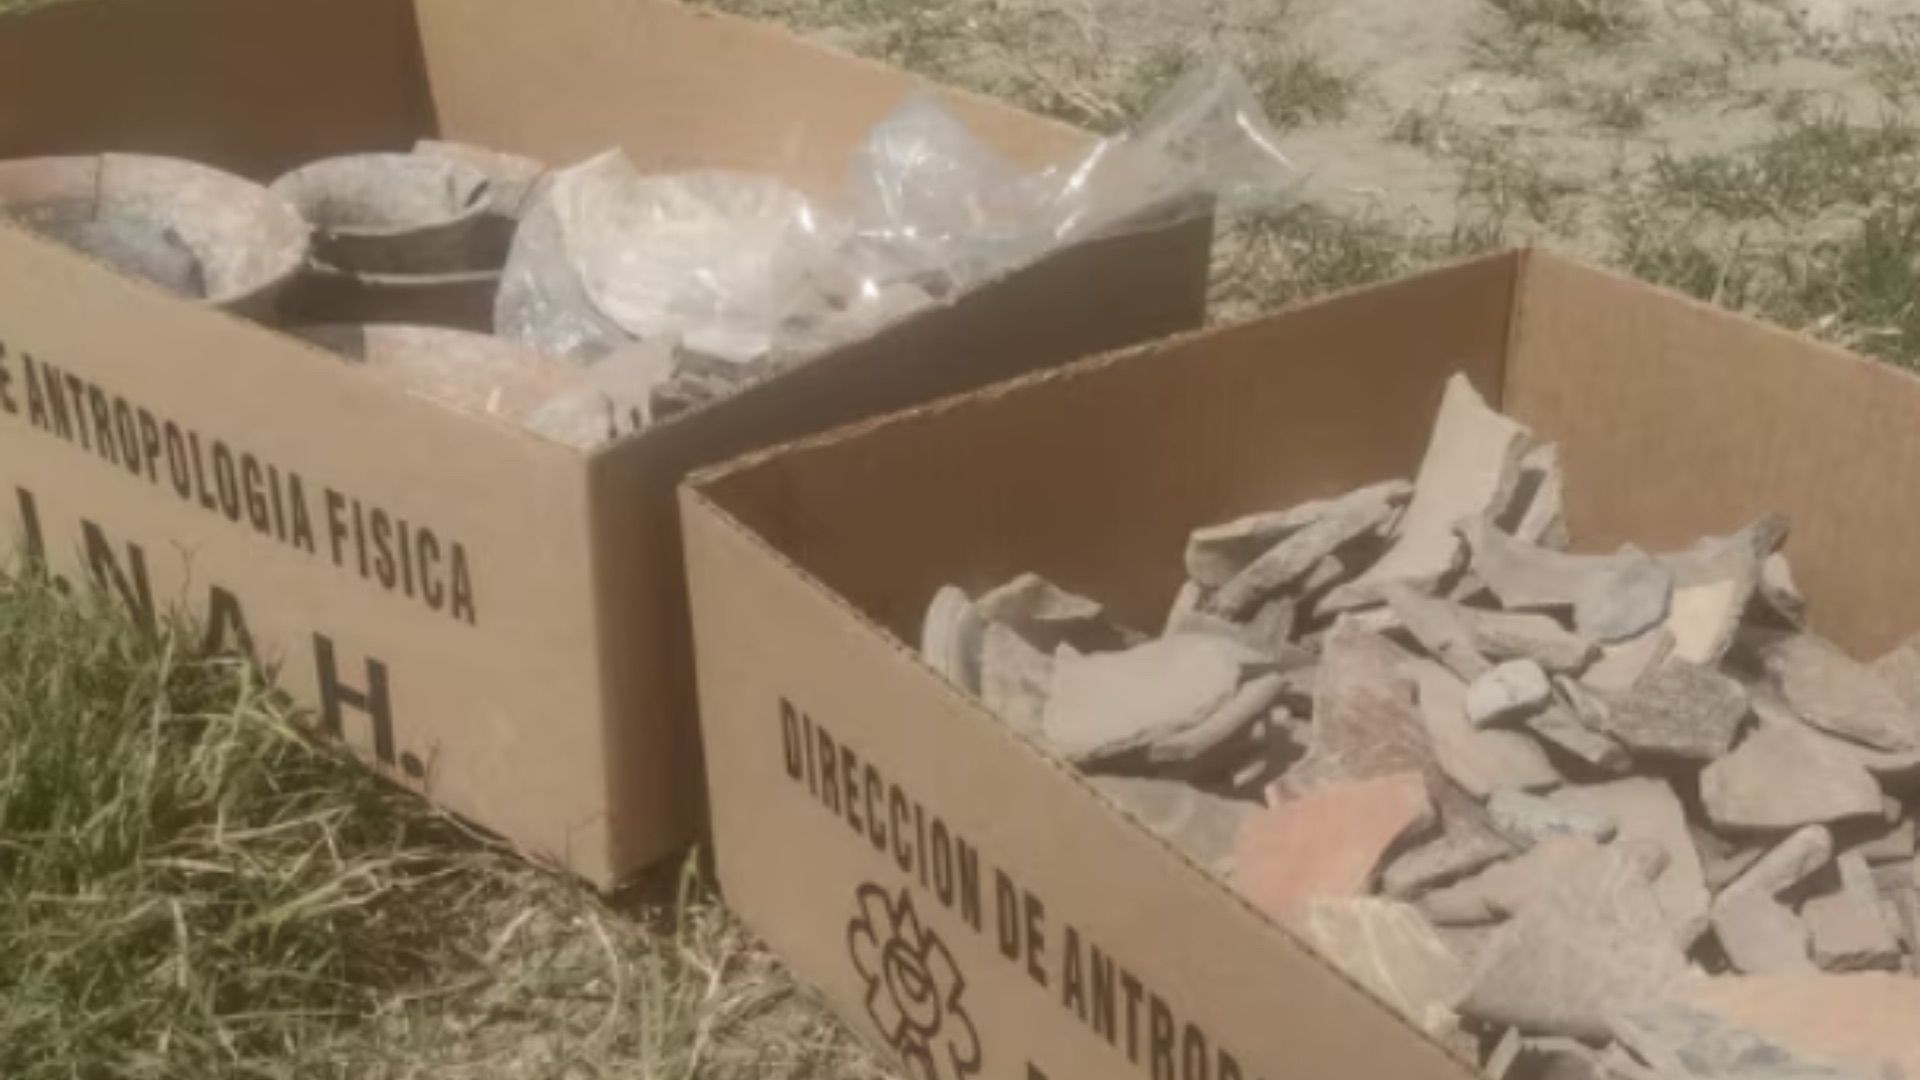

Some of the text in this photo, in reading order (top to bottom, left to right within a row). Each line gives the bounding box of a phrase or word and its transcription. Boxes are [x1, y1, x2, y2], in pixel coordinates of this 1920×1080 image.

[23, 353, 315, 555] ANTROPOLOGIA
[325, 488, 477, 627] FISICA
[779, 696, 983, 932] DIRECCION
[996, 867, 1049, 987] DE
